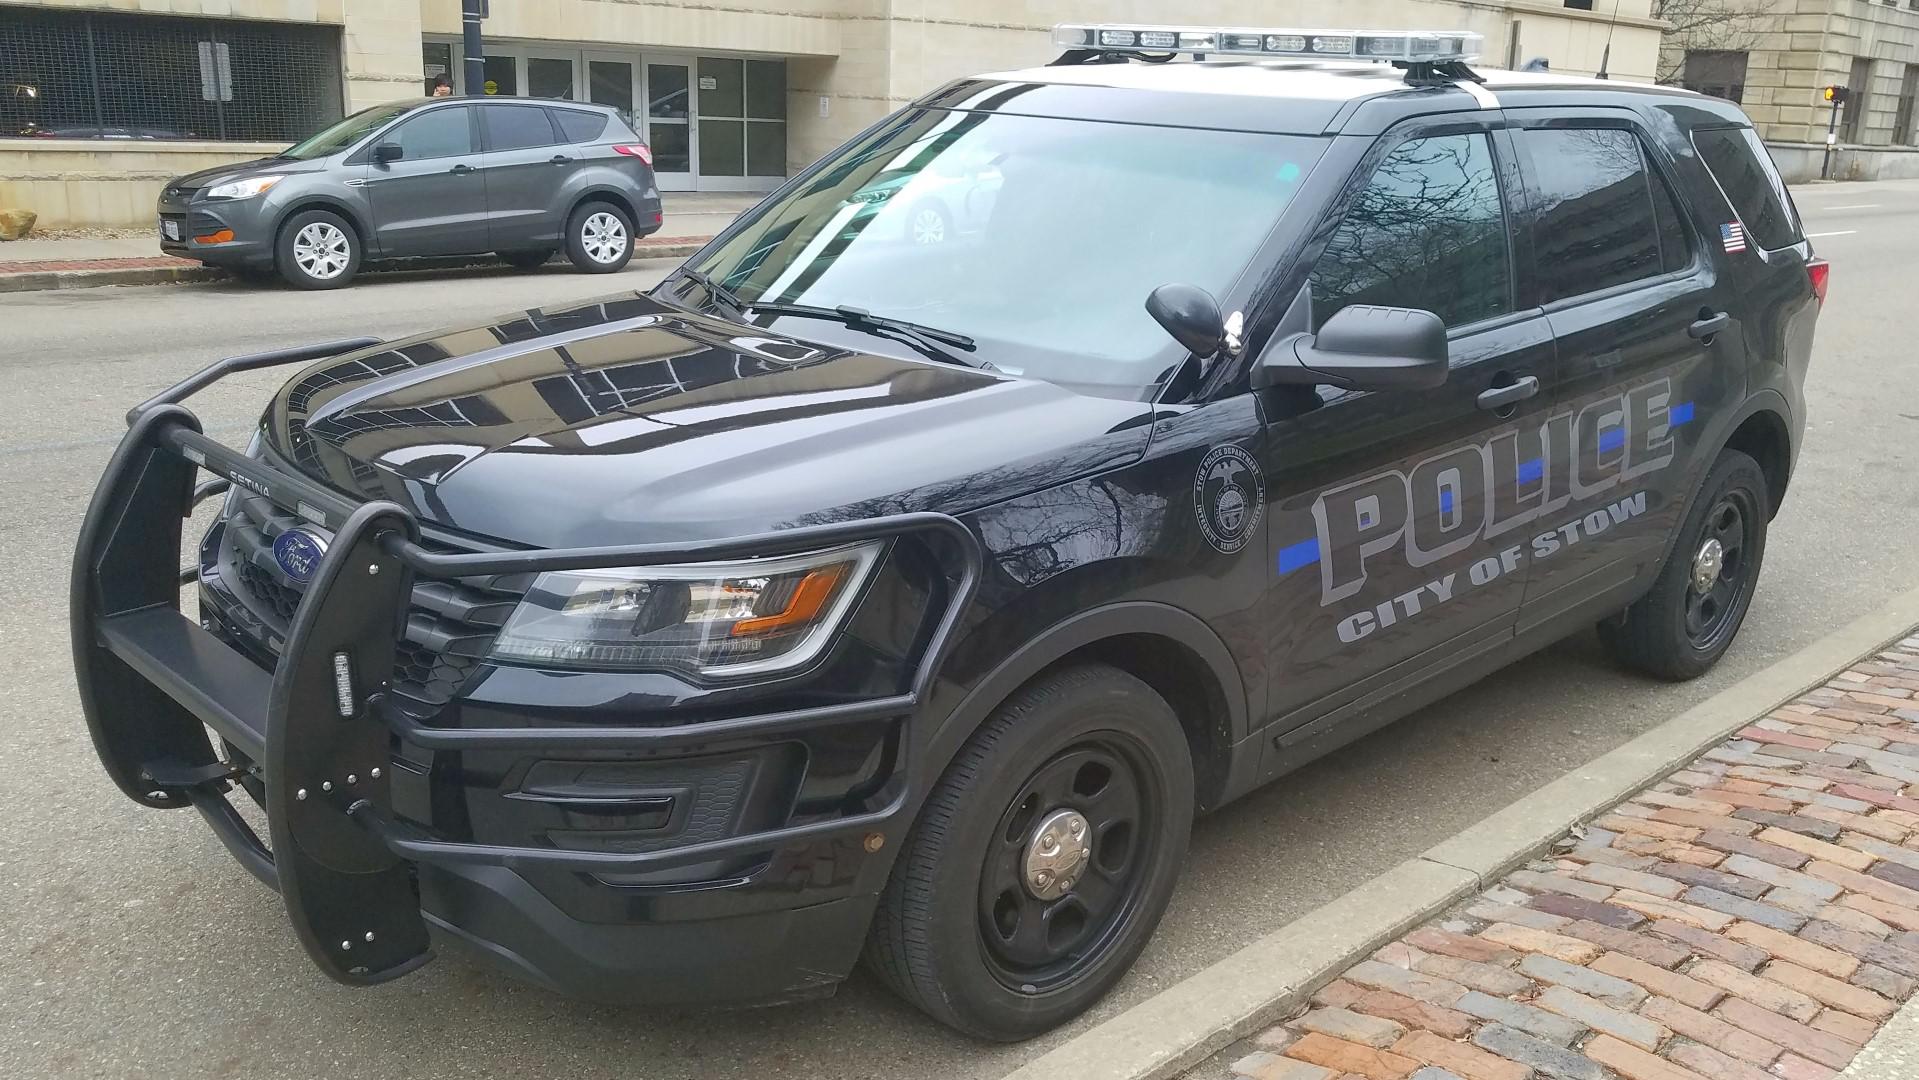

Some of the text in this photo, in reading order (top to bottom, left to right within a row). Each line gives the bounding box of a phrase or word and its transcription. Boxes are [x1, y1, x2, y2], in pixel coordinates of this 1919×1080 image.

[230, 470, 269, 497] SETINA
[1197, 447, 1259, 491] STOW POLICE DEPARTMENT
[1311, 376, 1674, 606] POLICE
[1196, 504, 1217, 543] INTEGRITY
[1220, 540, 1241, 551] SERVICE
[1244, 487, 1263, 539] COMMITMENT
[278, 537, 313, 575] Ford
[1336, 491, 1647, 643] CITY OF STOW
